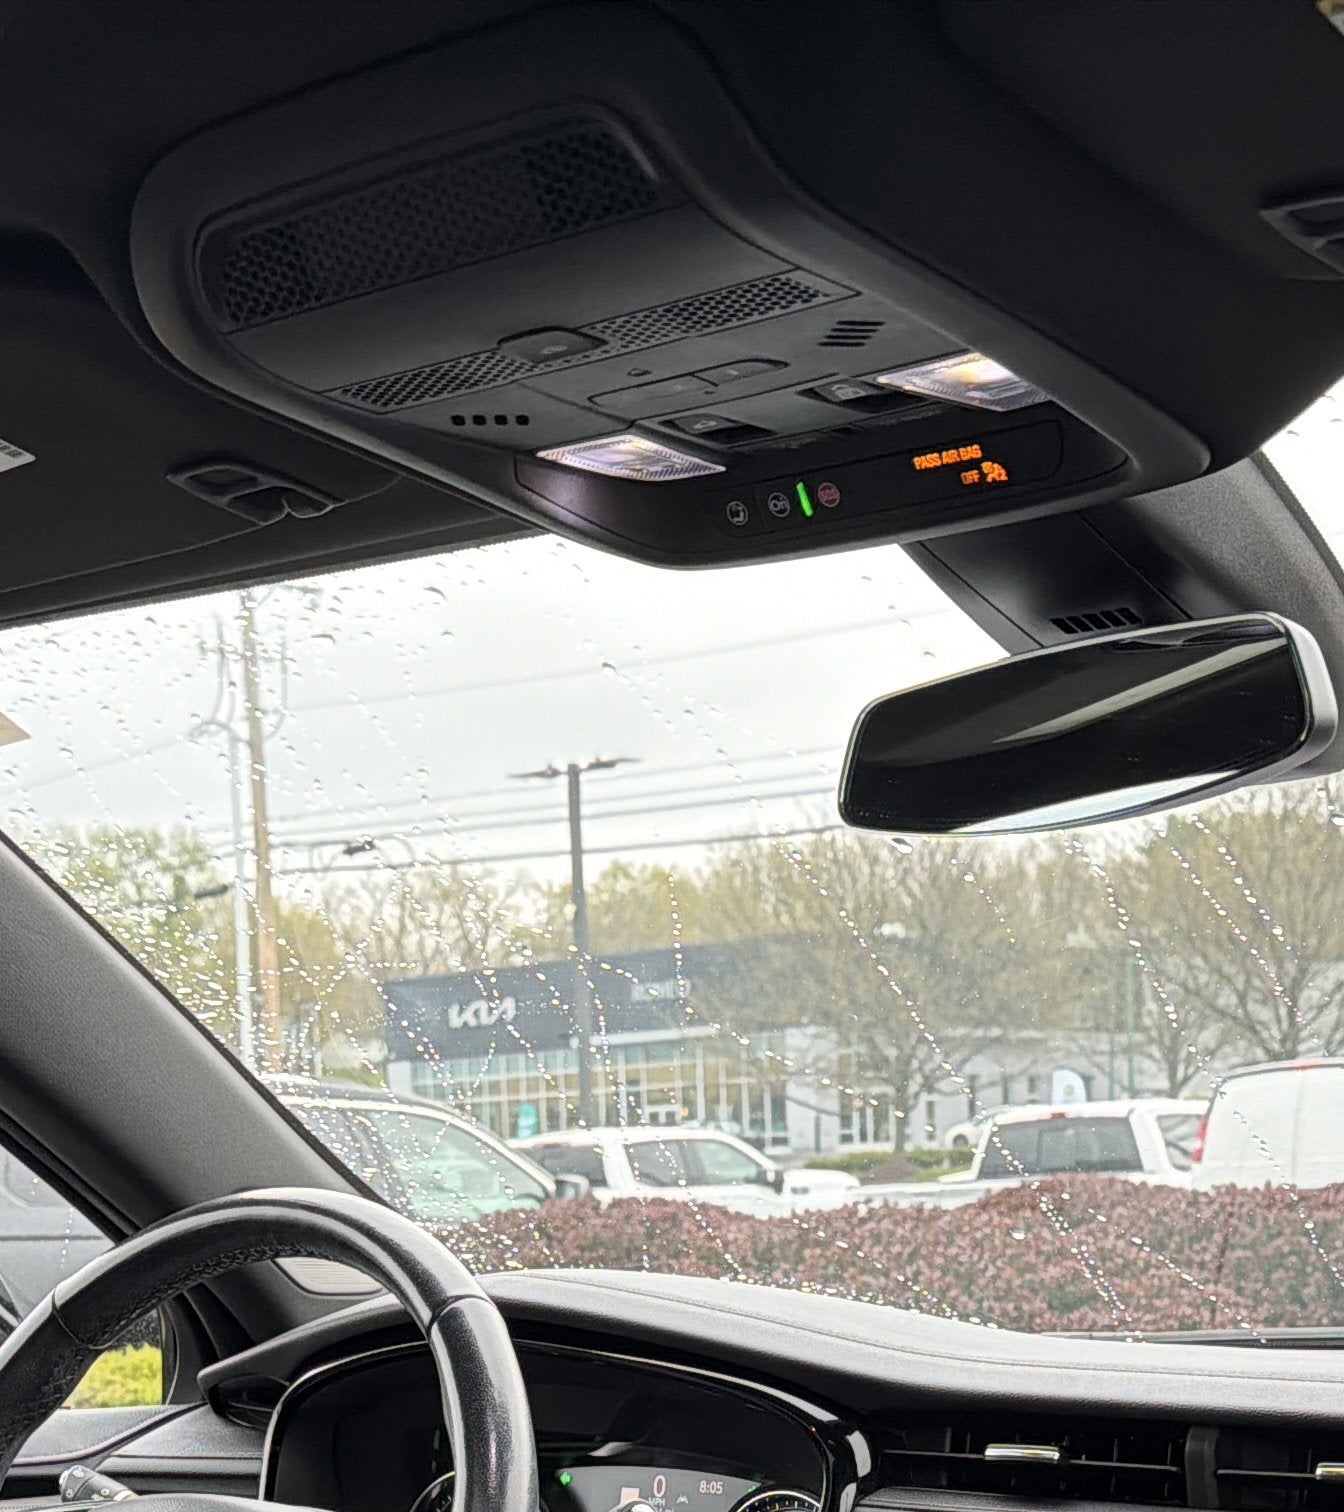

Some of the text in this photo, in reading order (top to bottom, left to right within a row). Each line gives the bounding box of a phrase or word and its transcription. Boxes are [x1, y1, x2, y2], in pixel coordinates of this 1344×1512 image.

[913, 444, 982, 470] PASS AIR BAG
[960, 469, 980, 485] OFF
[653, 1474, 666, 1498] 0
[699, 1480, 724, 1495] 8:05
